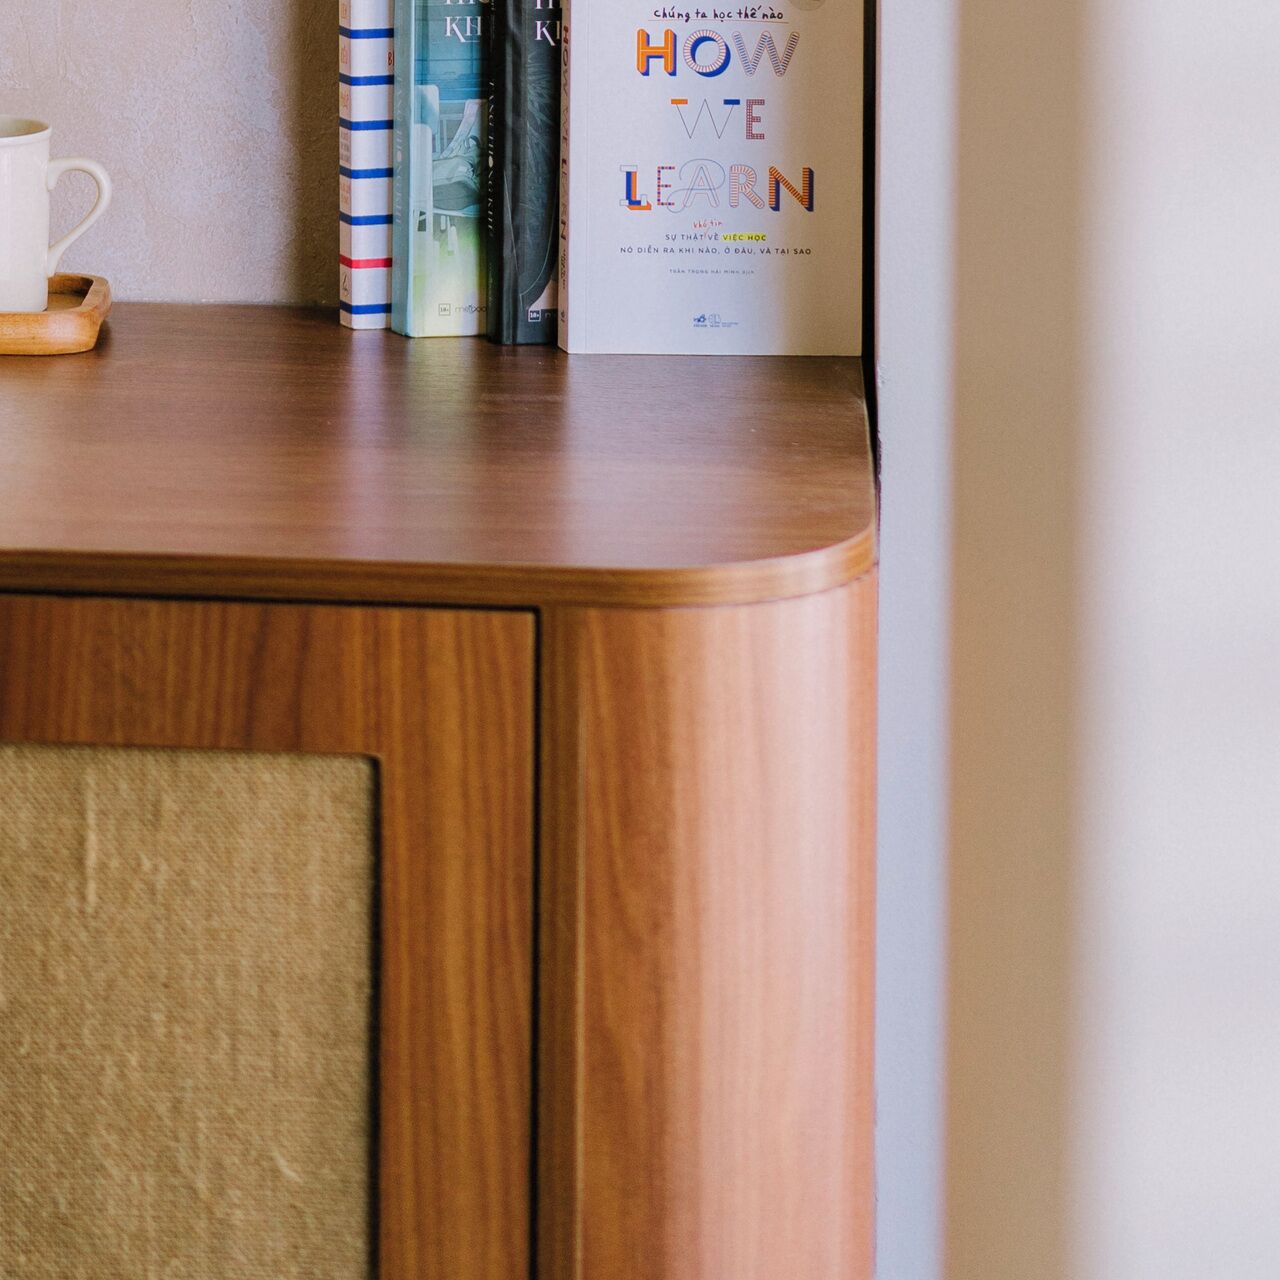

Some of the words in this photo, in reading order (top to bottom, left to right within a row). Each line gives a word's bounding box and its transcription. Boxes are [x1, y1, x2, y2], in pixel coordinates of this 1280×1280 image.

[653, 6, 691, 23] chúng
[695, 8, 708, 19] ta
[713, 8, 733, 23] học
[736, 5, 762, 19] thế
[762, 6, 784, 19] nào
[636, 28, 800, 78] HOW
[671, 98, 765, 140] WE
[620, 159, 814, 213] LEARN
[748, 234, 767, 243] HỌC
[793, 248, 812, 256] SAO
